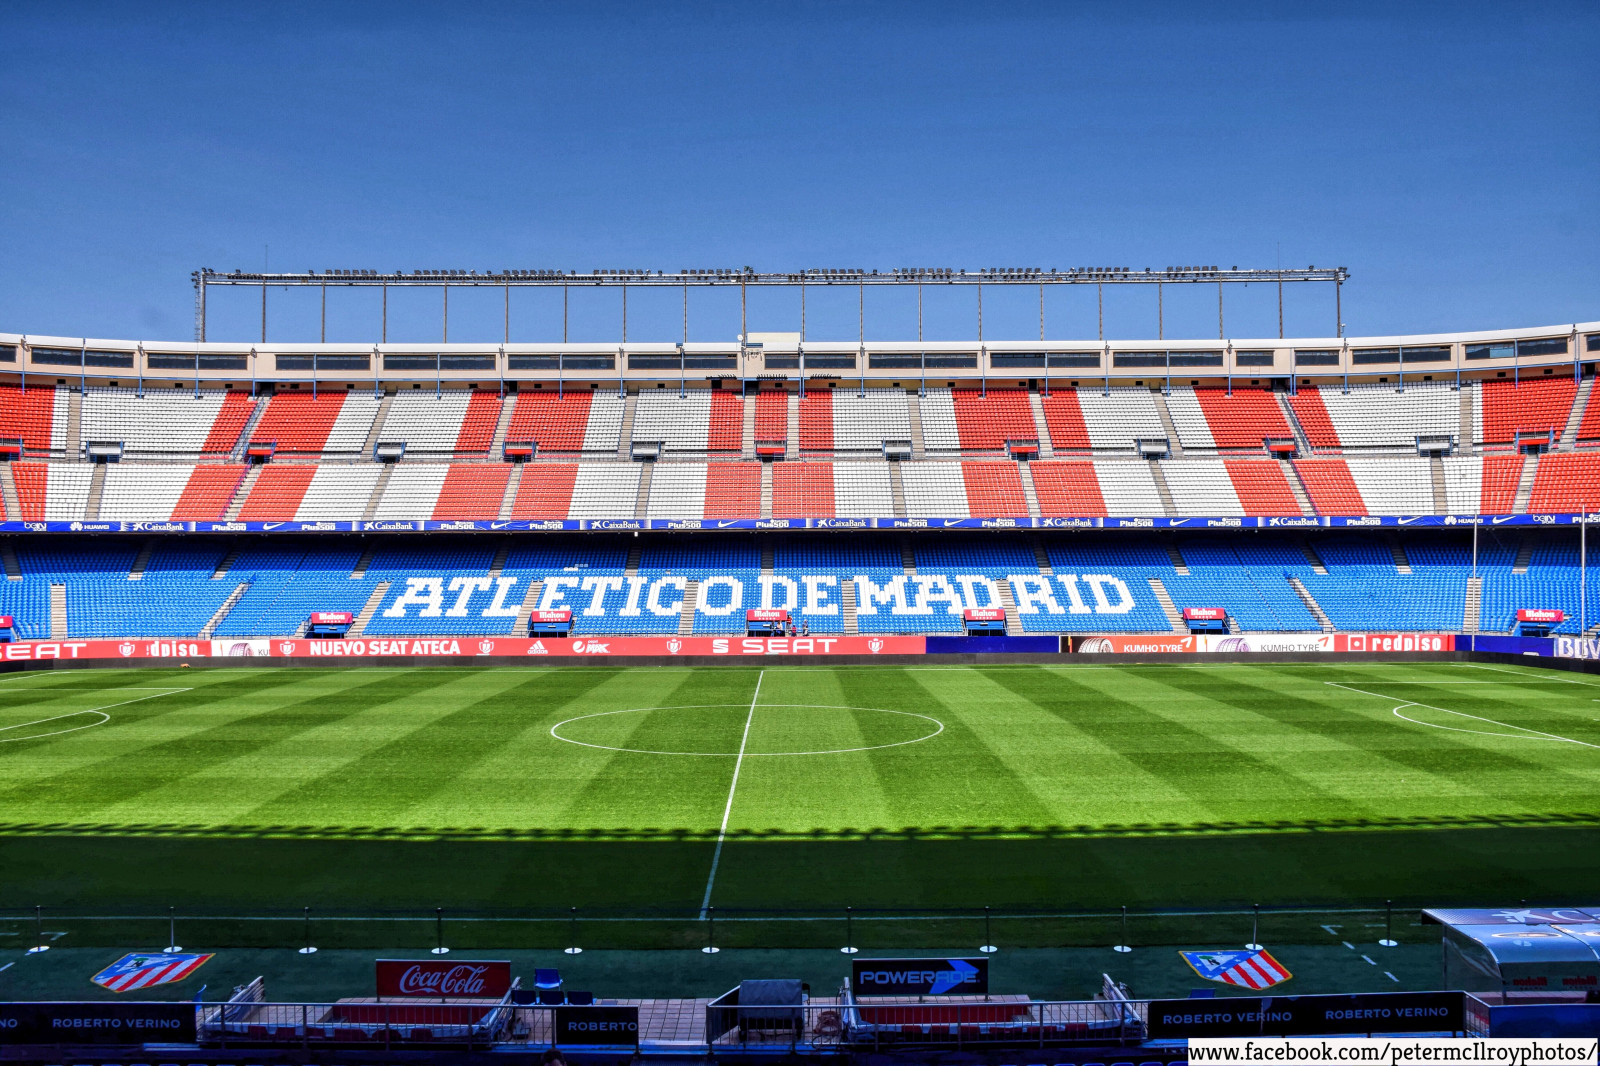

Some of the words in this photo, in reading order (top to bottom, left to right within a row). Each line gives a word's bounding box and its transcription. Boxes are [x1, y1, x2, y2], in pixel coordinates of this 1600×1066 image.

[144, 522, 184, 531] CaixaBank
[374, 522, 413, 531] CaixaBank
[602, 520, 640, 529] CaixaBank
[828, 519, 867, 527] CaixaBank
[1054, 518, 1092, 527] CaixaBank
[1280, 517, 1319, 526] CaixaBank
[757, 575, 839, 615] DE
[854, 574, 1136, 615] MADRID
[310, 641, 365, 656] NUEVO
[368, 641, 409, 655] SEAT
[411, 640, 461, 655] ATECA
[742, 638, 838, 655] SEAT
[1123, 644, 1159, 653] KUMHO
[1160, 644, 1183, 653] TYRE
[1260, 644, 1296, 652] KUMHO
[1299, 644, 1320, 652] TYRE
[1372, 635, 1442, 651] redpiso
[258, 648, 270, 656] KU
[400, 965, 489, 994] Coca-Cola
[860, 970, 977, 984] POWERADE
[1163, 1013, 1232, 1025] ROBERTO
[1236, 1011, 1292, 1023] VERINO
[1326, 1008, 1391, 1020] ROBERTO
[1395, 1007, 1449, 1018] VERINO
[52, 1018, 121, 1029] ROBERTO
[126, 1018, 181, 1029] VERINO
[568, 1021, 638, 1032] ROBERTO
